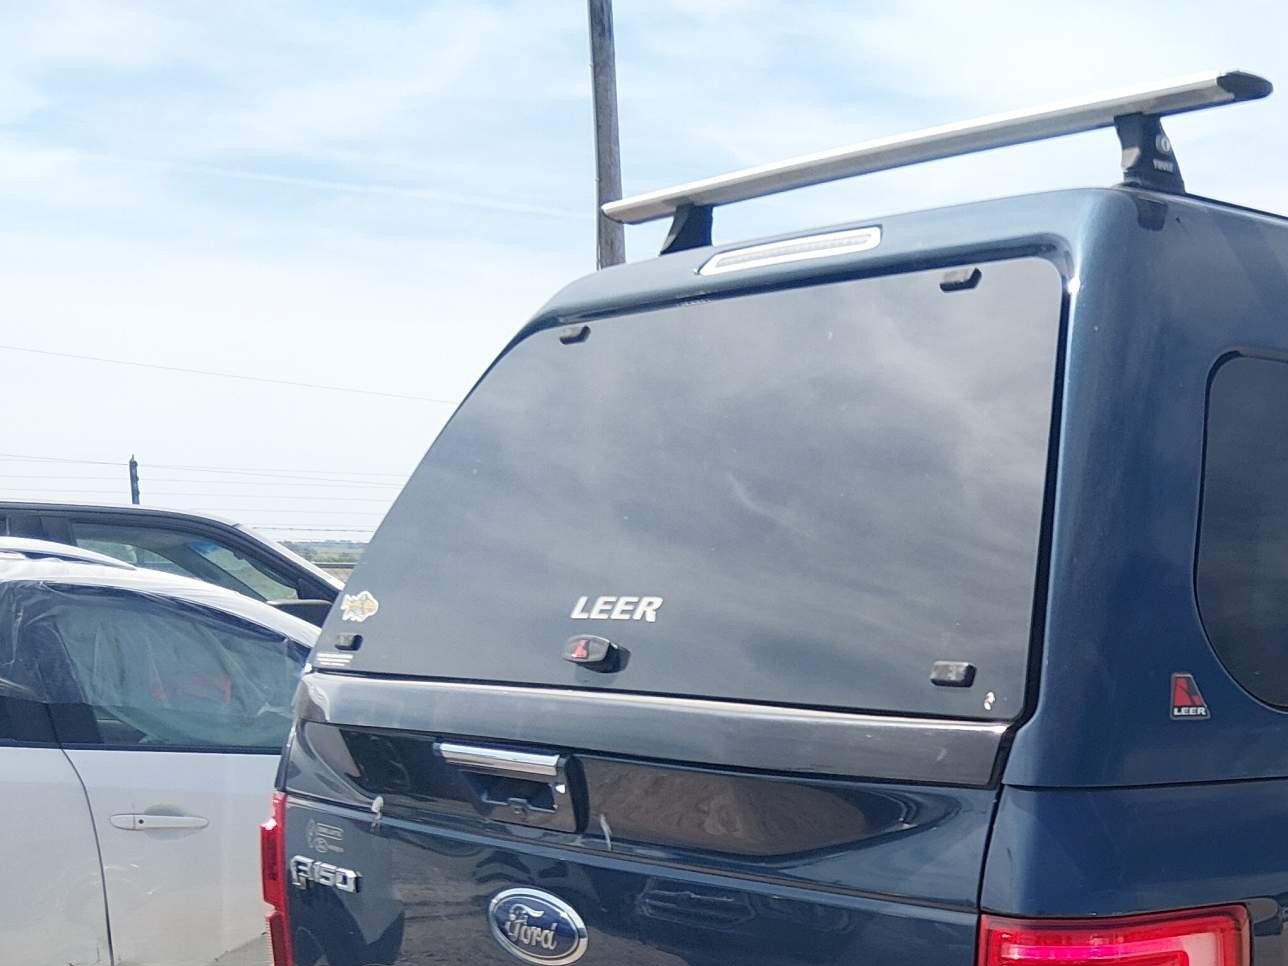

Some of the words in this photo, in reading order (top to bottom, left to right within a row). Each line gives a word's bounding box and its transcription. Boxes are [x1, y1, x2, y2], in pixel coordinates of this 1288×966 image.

[570, 596, 663, 622] LEER
[1173, 706, 1207, 716] LEER
[505, 903, 558, 950] Ford
